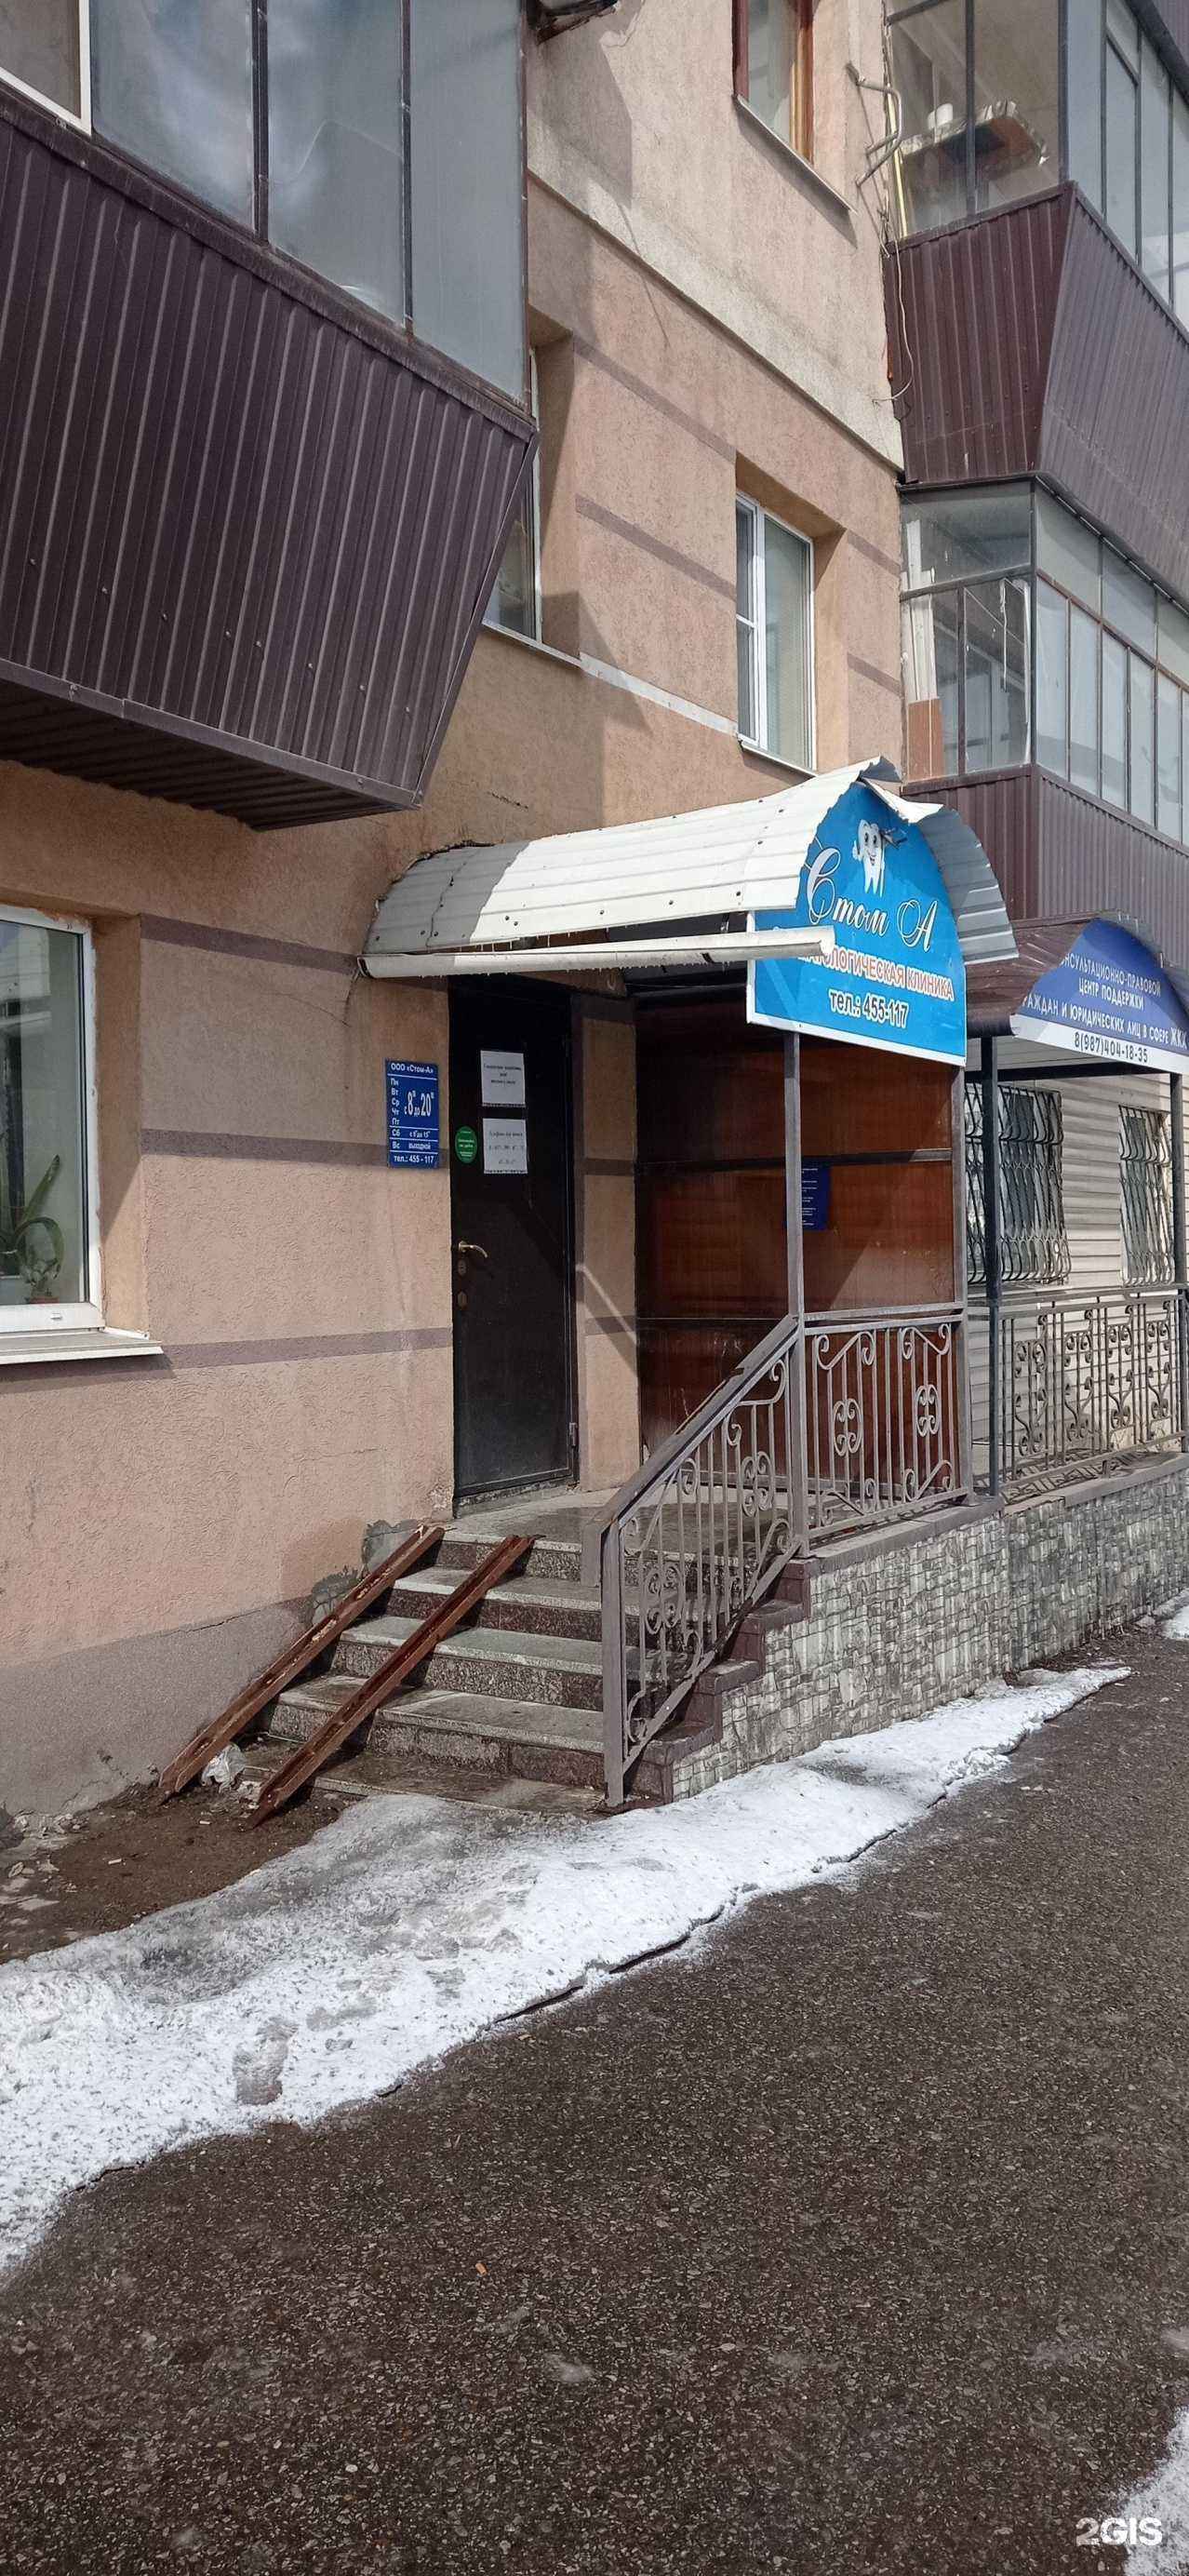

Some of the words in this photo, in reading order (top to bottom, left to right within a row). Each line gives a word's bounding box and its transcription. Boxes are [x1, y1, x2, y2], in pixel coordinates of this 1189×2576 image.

[806, 837, 889, 936] Стом
[897, 899, 938, 953] А
[797, 945, 906, 988] ОЛОГИЧЕСКАЯ
[907, 965, 955, 1001] КЛИНИКА
[1061, 953, 1161, 997] НСУЛЬТАЦИОННО-ПРАВОВОЙ
[829, 989, 862, 1017] тел.:
[862, 992, 909, 1028] 455-117
[1078, 977, 1100, 997] ЦЕНТР
[1102, 986, 1144, 1011] ПОДДЕРЖКИ
[1062, 1004, 1068, 1017] И
[1070, 1005, 1125, 1032] ЮРИДИЧЕСКИХ
[1127, 1021, 1141, 1040] ЛИЦ
[1149, 1026, 1169, 1044] СФЕРЕ
[1075, 1032, 1148, 1063] 8(987)404-18-35
[391, 1063, 406, 1072] ООО
[391, 1078, 399, 1086] Пн
[392, 1098, 400, 1107] Ср
[392, 1141, 400, 1149] Вс
